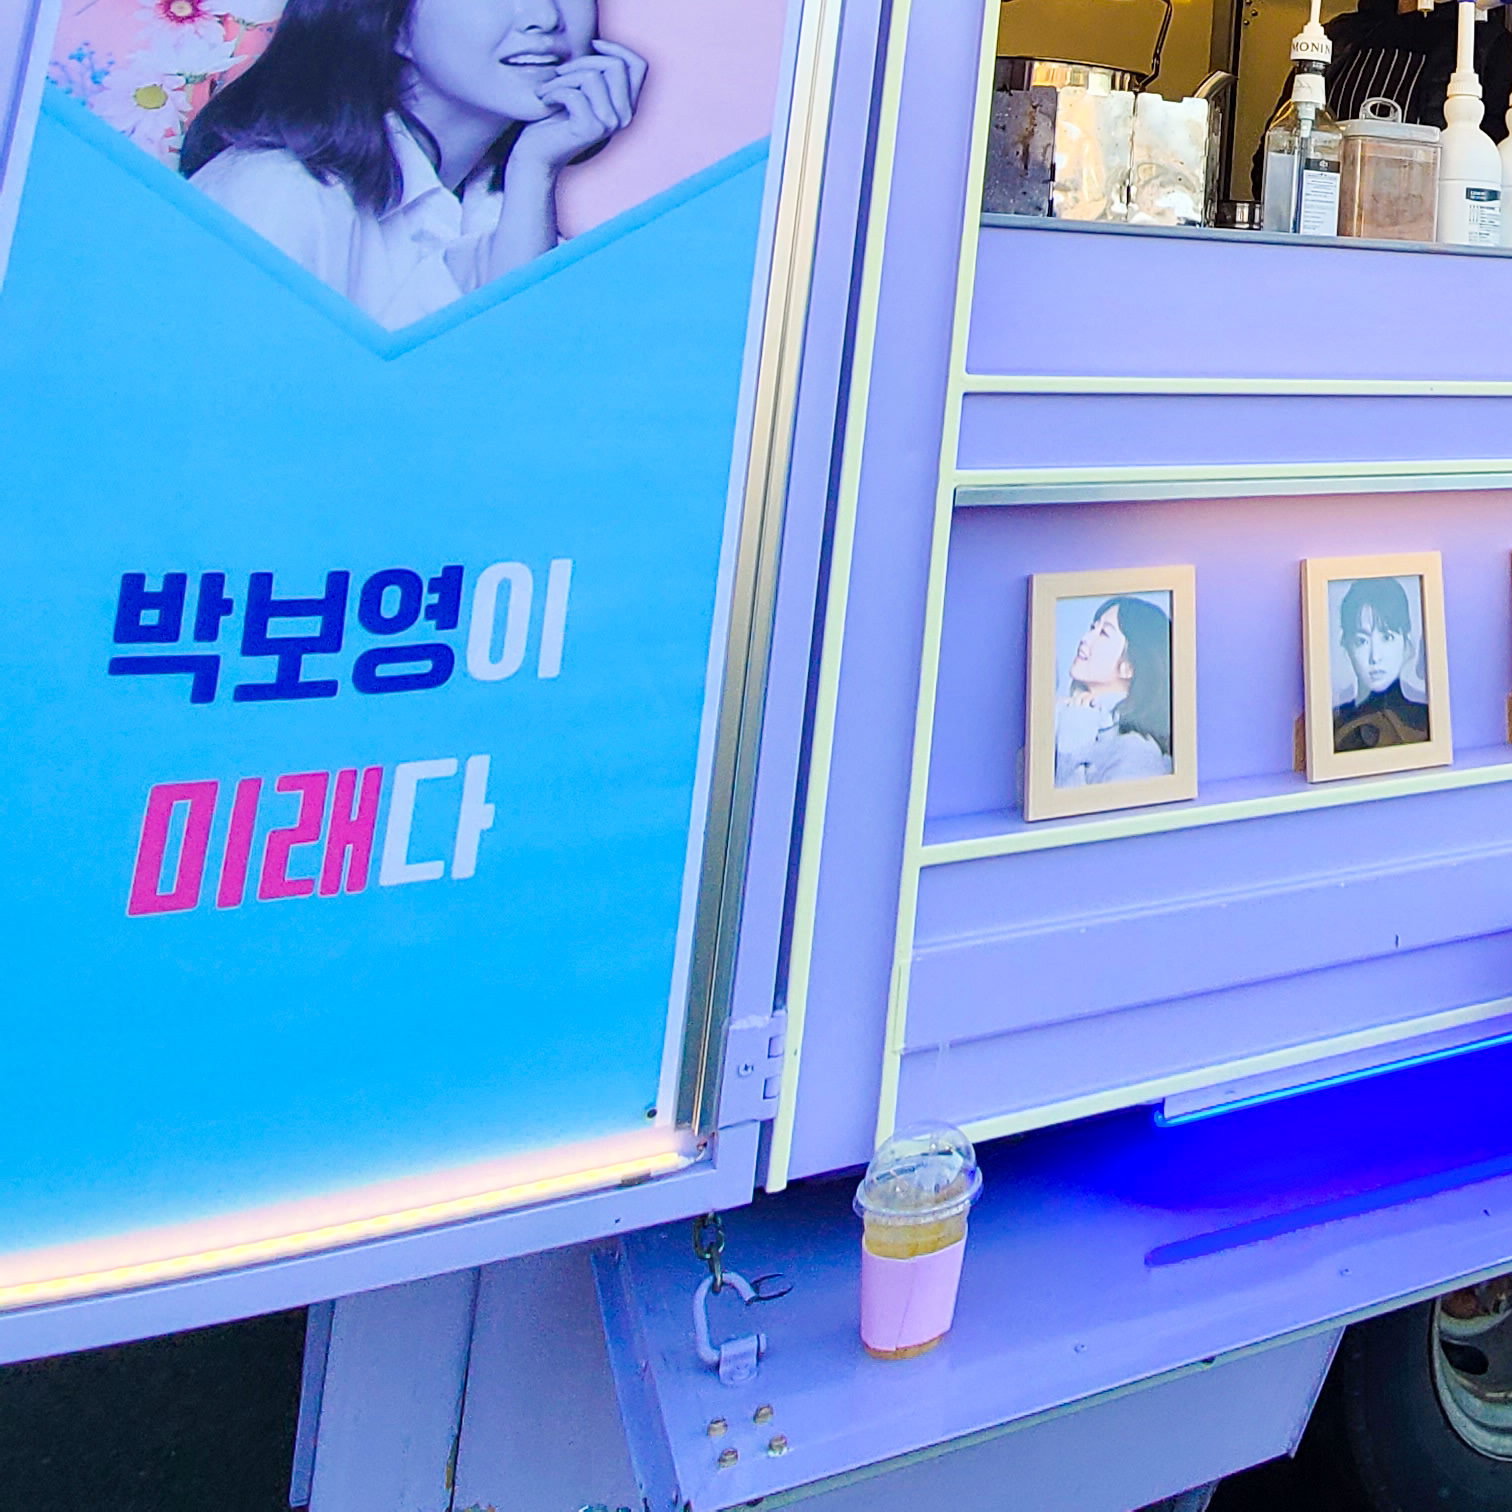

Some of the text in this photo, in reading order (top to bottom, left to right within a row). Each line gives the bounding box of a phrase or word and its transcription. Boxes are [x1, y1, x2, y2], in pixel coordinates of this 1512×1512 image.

[1292, 41, 1331, 55] MONIN
[108, 558, 573, 705] 박보영이
[127, 754, 496, 917] 미래다
